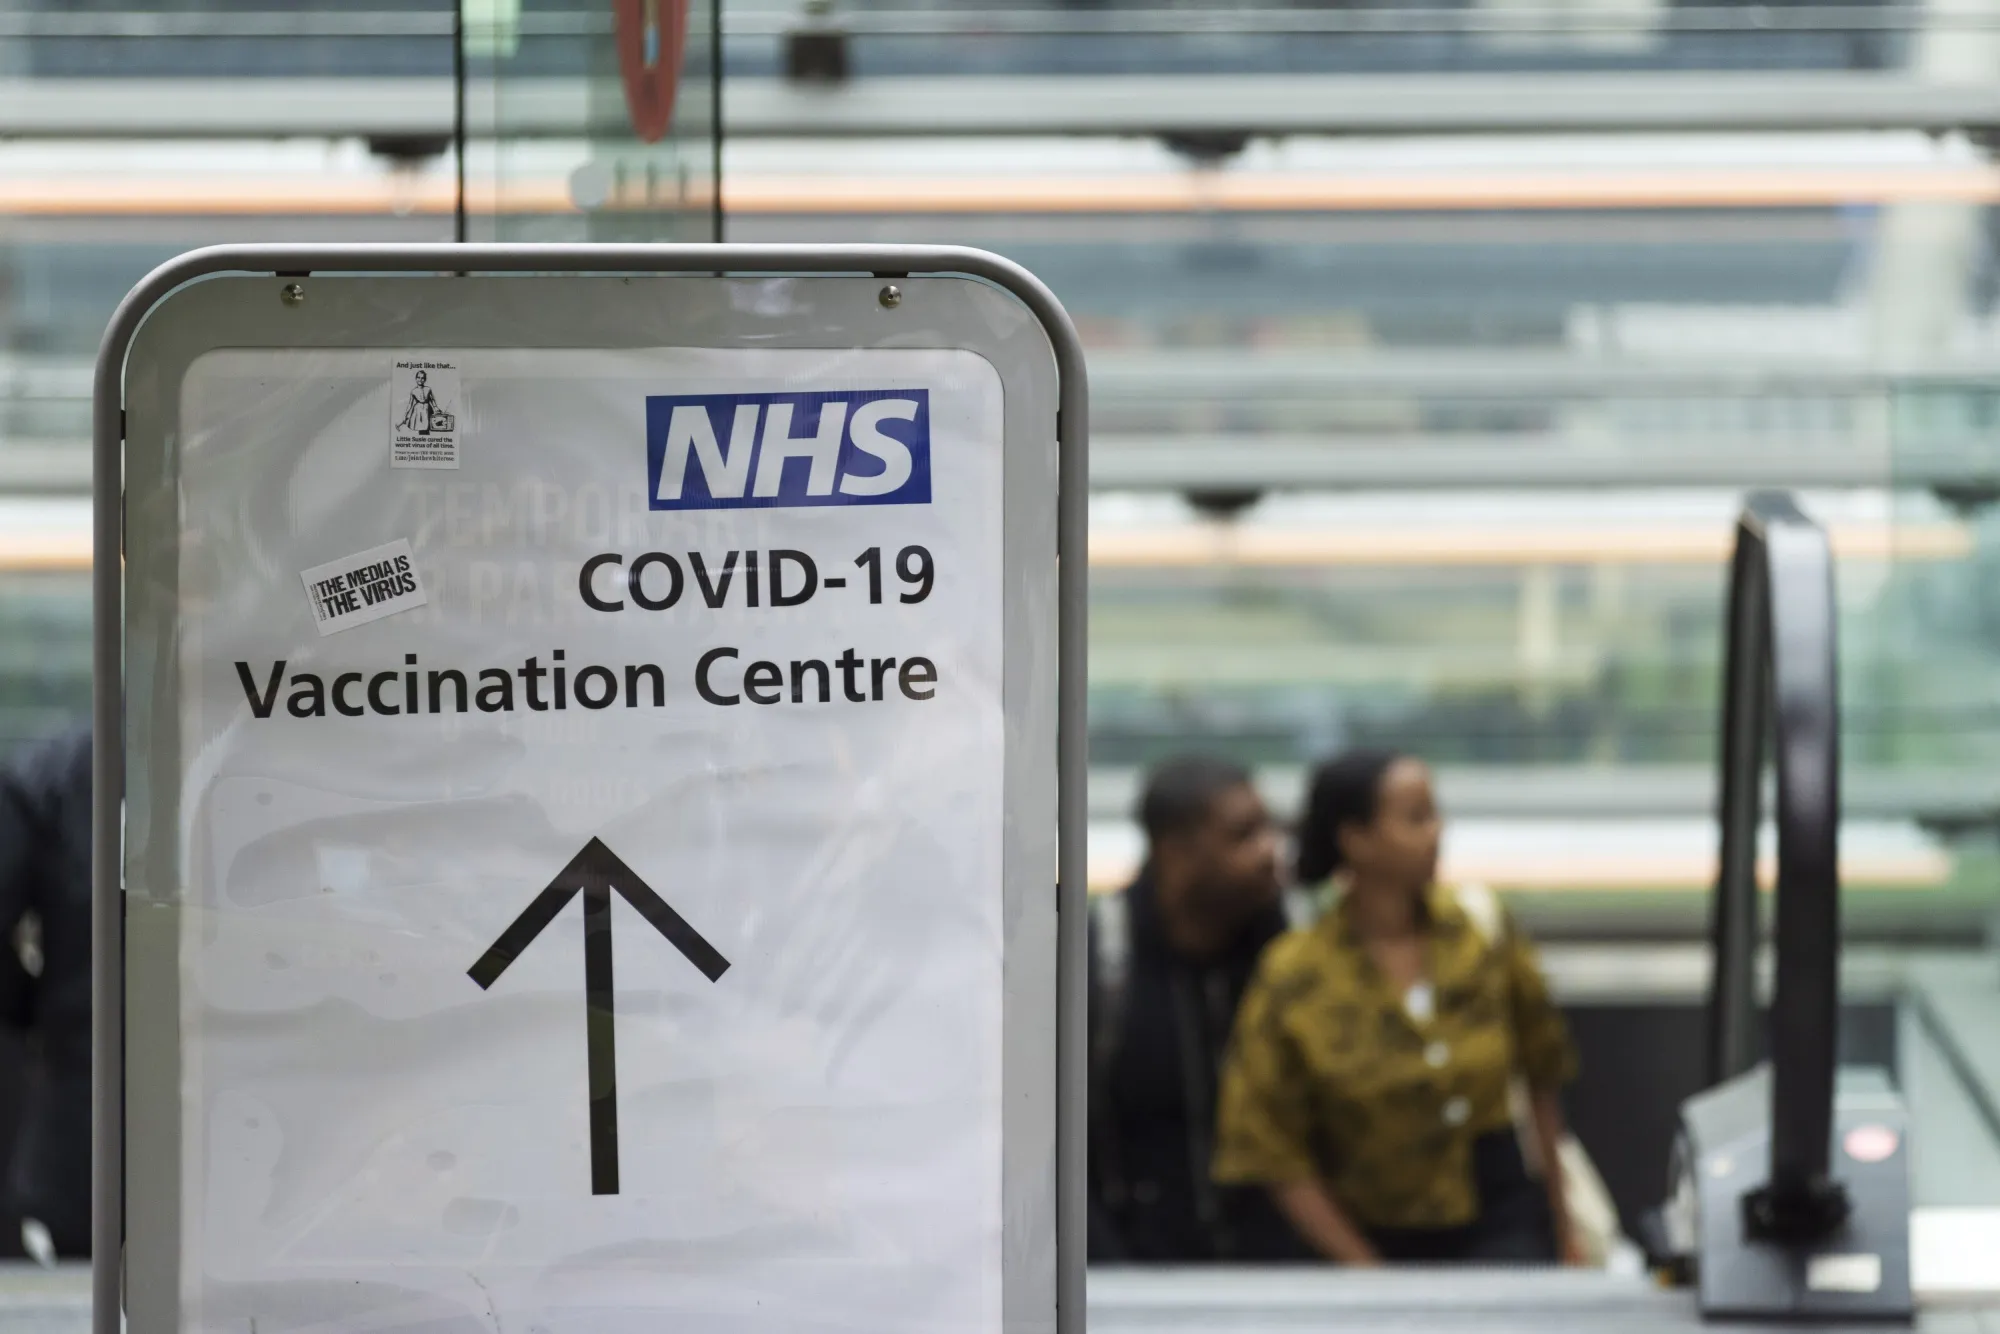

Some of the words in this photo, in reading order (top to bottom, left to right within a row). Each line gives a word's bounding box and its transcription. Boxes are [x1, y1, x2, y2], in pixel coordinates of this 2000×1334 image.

[409, 362, 423, 370] just
[656, 399, 919, 500] NHS
[317, 575, 347, 598] THE
[345, 560, 395, 589] MEDIA
[393, 555, 410, 573] IS
[322, 589, 362, 619] THE
[359, 571, 417, 606] VIRUS
[579, 546, 934, 612] COVID-19
[234, 650, 664, 718] Vaccination
[696, 647, 937, 705] Centre
